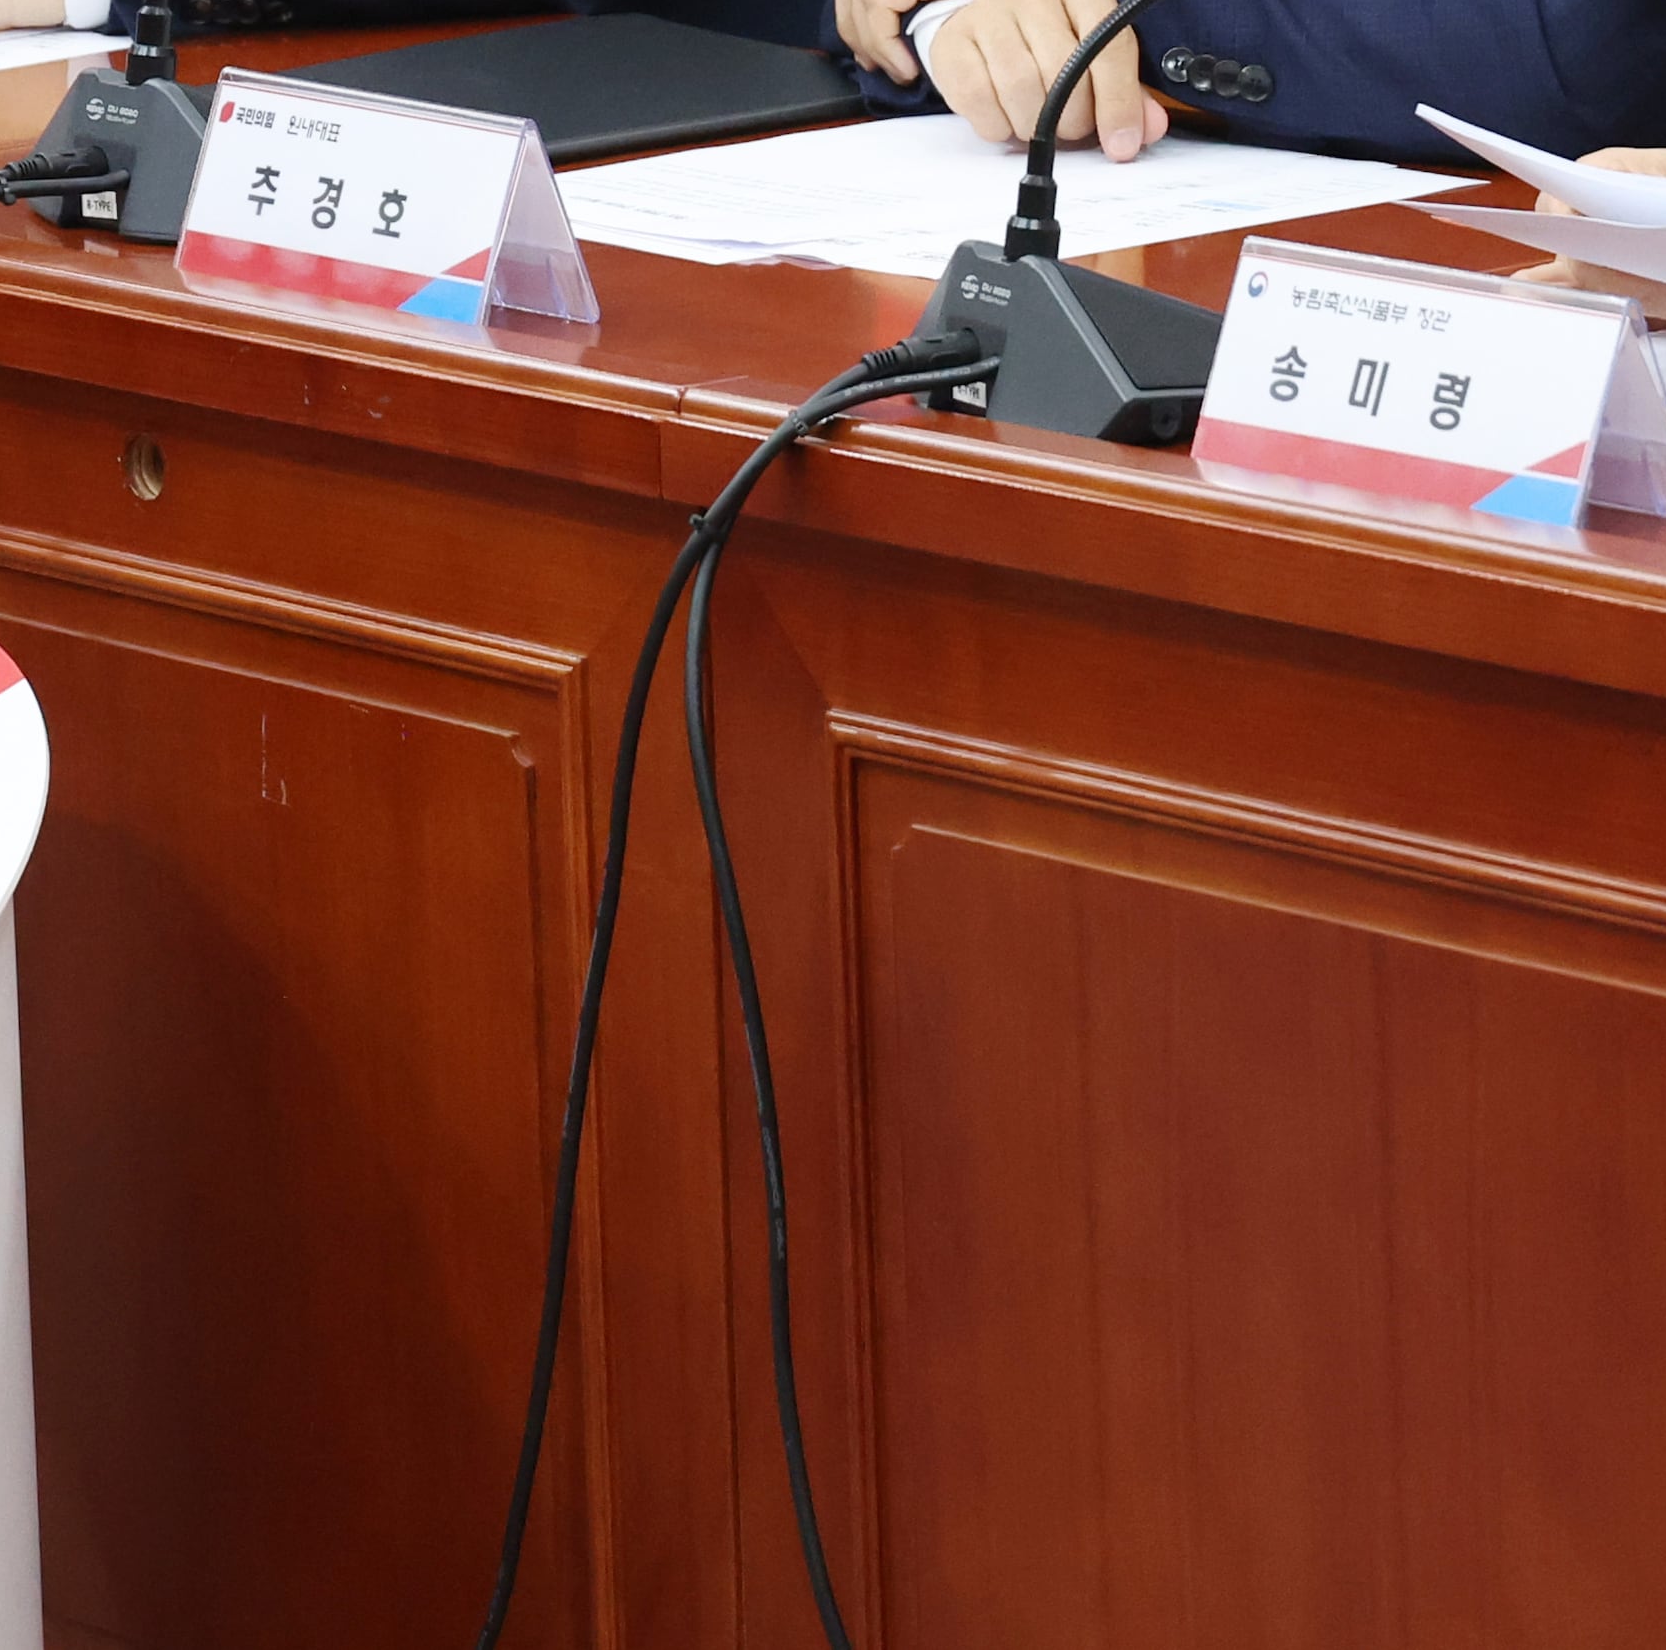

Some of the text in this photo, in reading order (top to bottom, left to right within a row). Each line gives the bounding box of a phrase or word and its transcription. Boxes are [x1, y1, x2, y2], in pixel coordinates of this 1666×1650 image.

[236, 107, 342, 143] 국민의힘 원내대표
[1292, 285, 1452, 332] 농림축산식품부 장관
